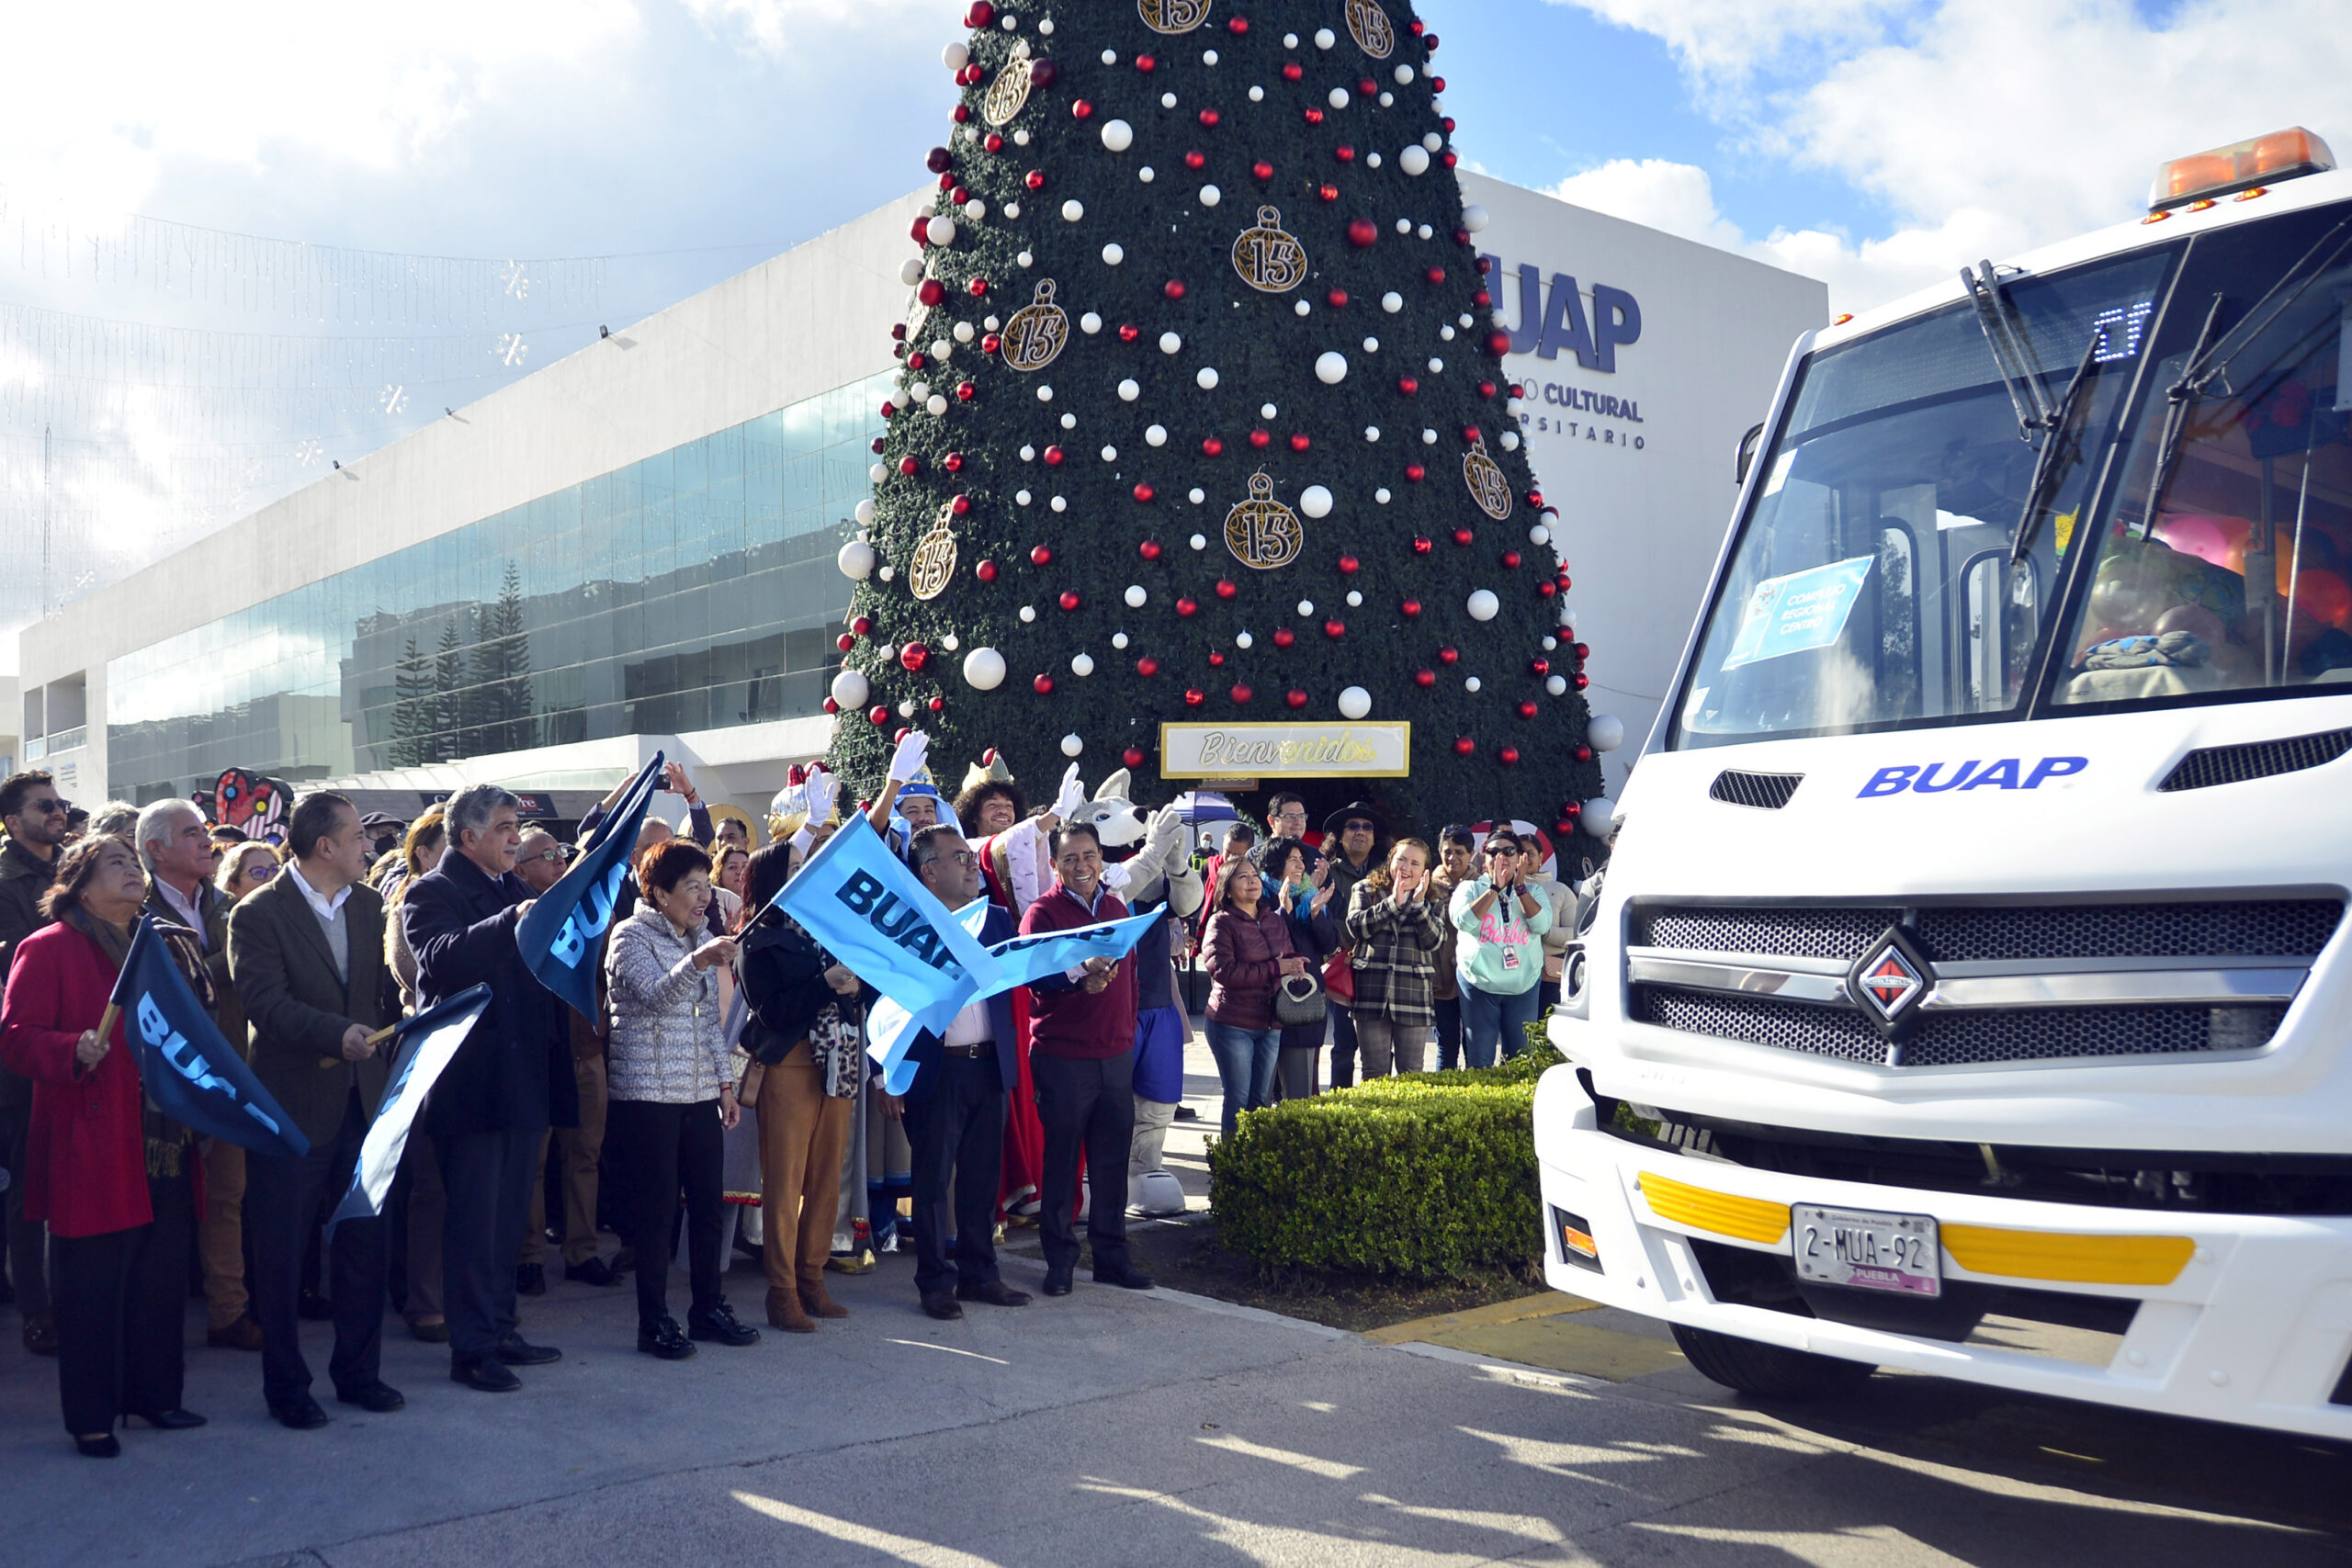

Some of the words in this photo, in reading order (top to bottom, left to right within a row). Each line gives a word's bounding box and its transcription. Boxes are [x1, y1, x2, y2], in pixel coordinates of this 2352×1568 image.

[1354, 3, 1388, 53] 15
[1250, 238, 1295, 286] 15
[1481, 253, 1642, 374] UAP
[1014, 314, 1061, 365] 15
[1544, 382, 1644, 423] CULTURAL
[1521, 413, 1645, 449] RSITARIO
[1473, 463, 1507, 513] 15
[1243, 512, 1292, 562] 15
[919, 538, 953, 592] 15
[1780, 616, 1824, 635] CENTRO
[1198, 728, 1377, 767] Bienvenidos
[1855, 756, 2089, 799] BUAP
[1478, 913, 1531, 946] Barbie
[1804, 1226, 1924, 1269] 2-MUA-92
[1856, 1268, 1901, 1283] PUEBLA
